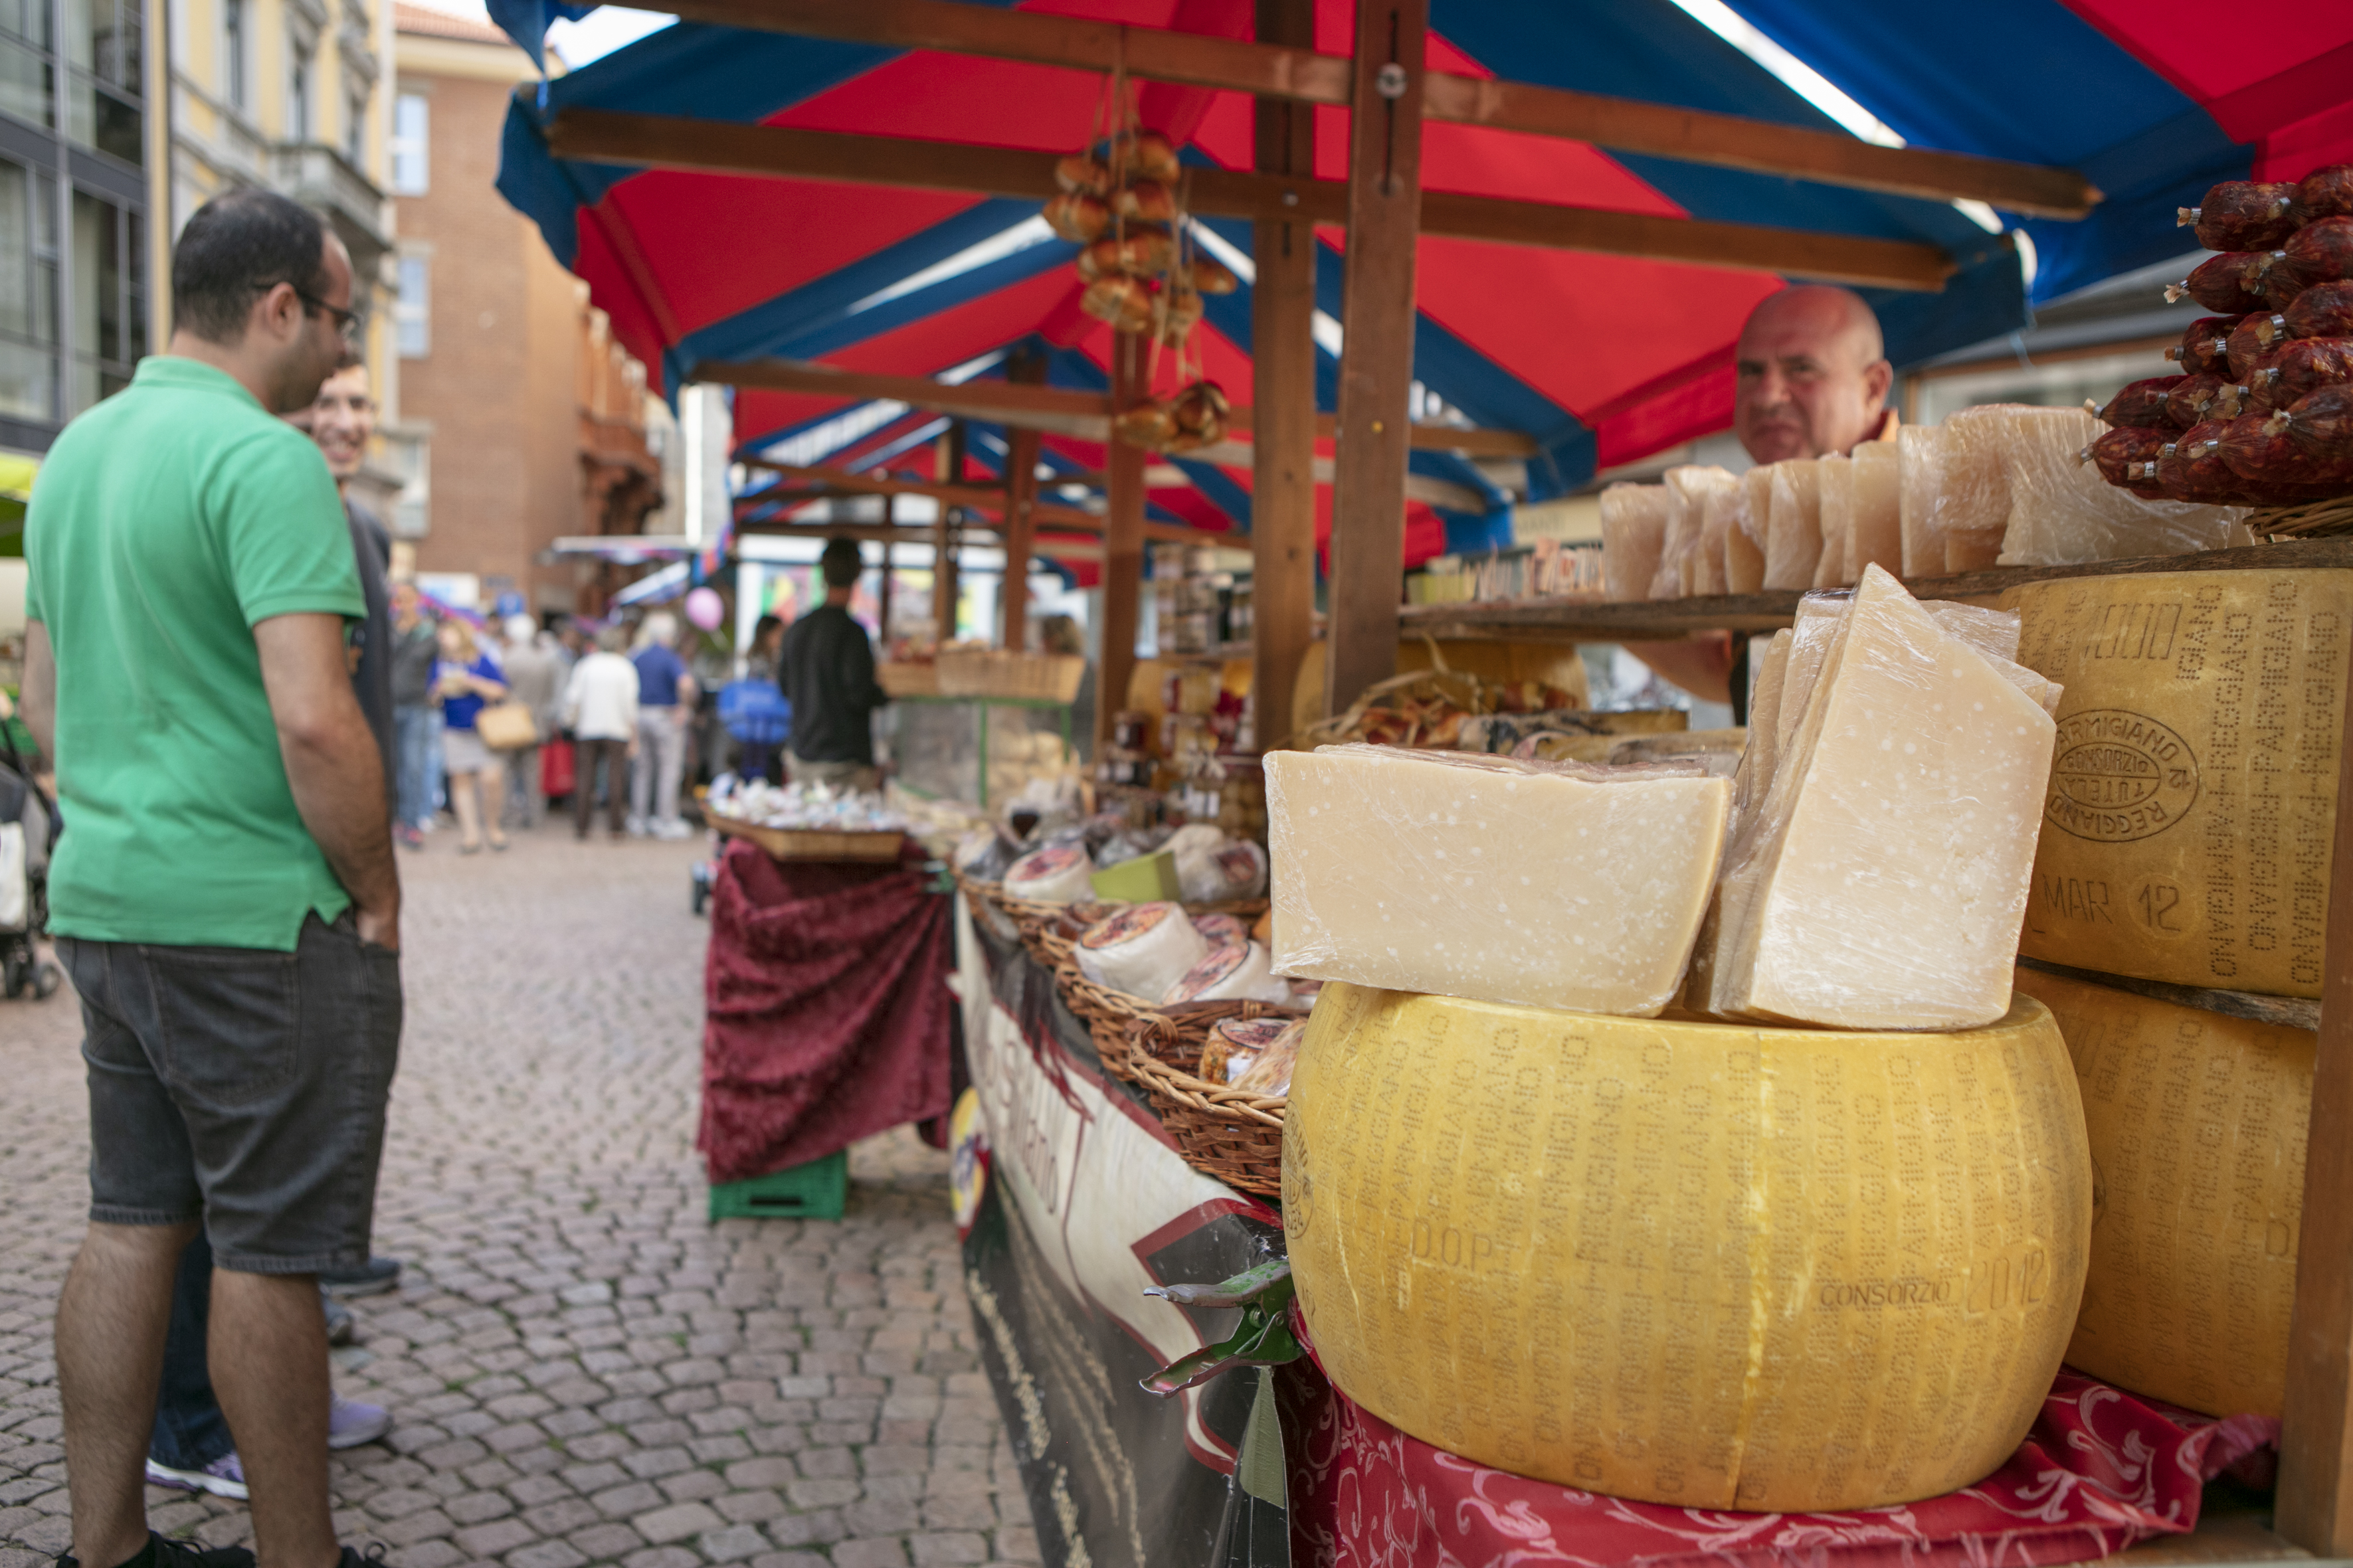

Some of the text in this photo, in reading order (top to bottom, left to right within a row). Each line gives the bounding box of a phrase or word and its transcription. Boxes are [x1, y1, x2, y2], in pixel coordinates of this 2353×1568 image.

[2055, 716, 2180, 761] ARMIGIANO
[2211, 610, 2253, 772] REGGIANO
[2252, 580, 2299, 774] PARMIGIANO
[2301, 610, 2339, 774] REGGIANO
[2049, 794, 2169, 835] REGGIANO
[2064, 777, 2145, 803] TUTELA
[2065, 748, 2150, 774] CONSORZIO
[2168, 768, 2192, 790] 12
[2042, 873, 2113, 924] MAR
[2138, 883, 2182, 932] 12
[2207, 792, 2237, 978] PARMIGIANO
[2249, 794, 2281, 952] REGGIANO
[2291, 795, 2328, 984] PARMIGIANO
[1389, 1013, 1449, 1222] PARMIGIANO
[1537, 1035, 1590, 1258] PARMIGIANO
[1574, 1077, 1624, 1263] REGGIANO
[1670, 1084, 1711, 1275] REGGIANO
[1814, 1054, 1846, 1284] PARMIGIANO
[1886, 1054, 1927, 1284] PARMIGIANO
[2149, 1019, 2203, 1203] PARMIGIANO
[2189, 1055, 2235, 1213] REGGIANO
[1820, 1281, 1951, 1307] CONSORZIO
[1965, 1249, 2046, 1314] 2012
